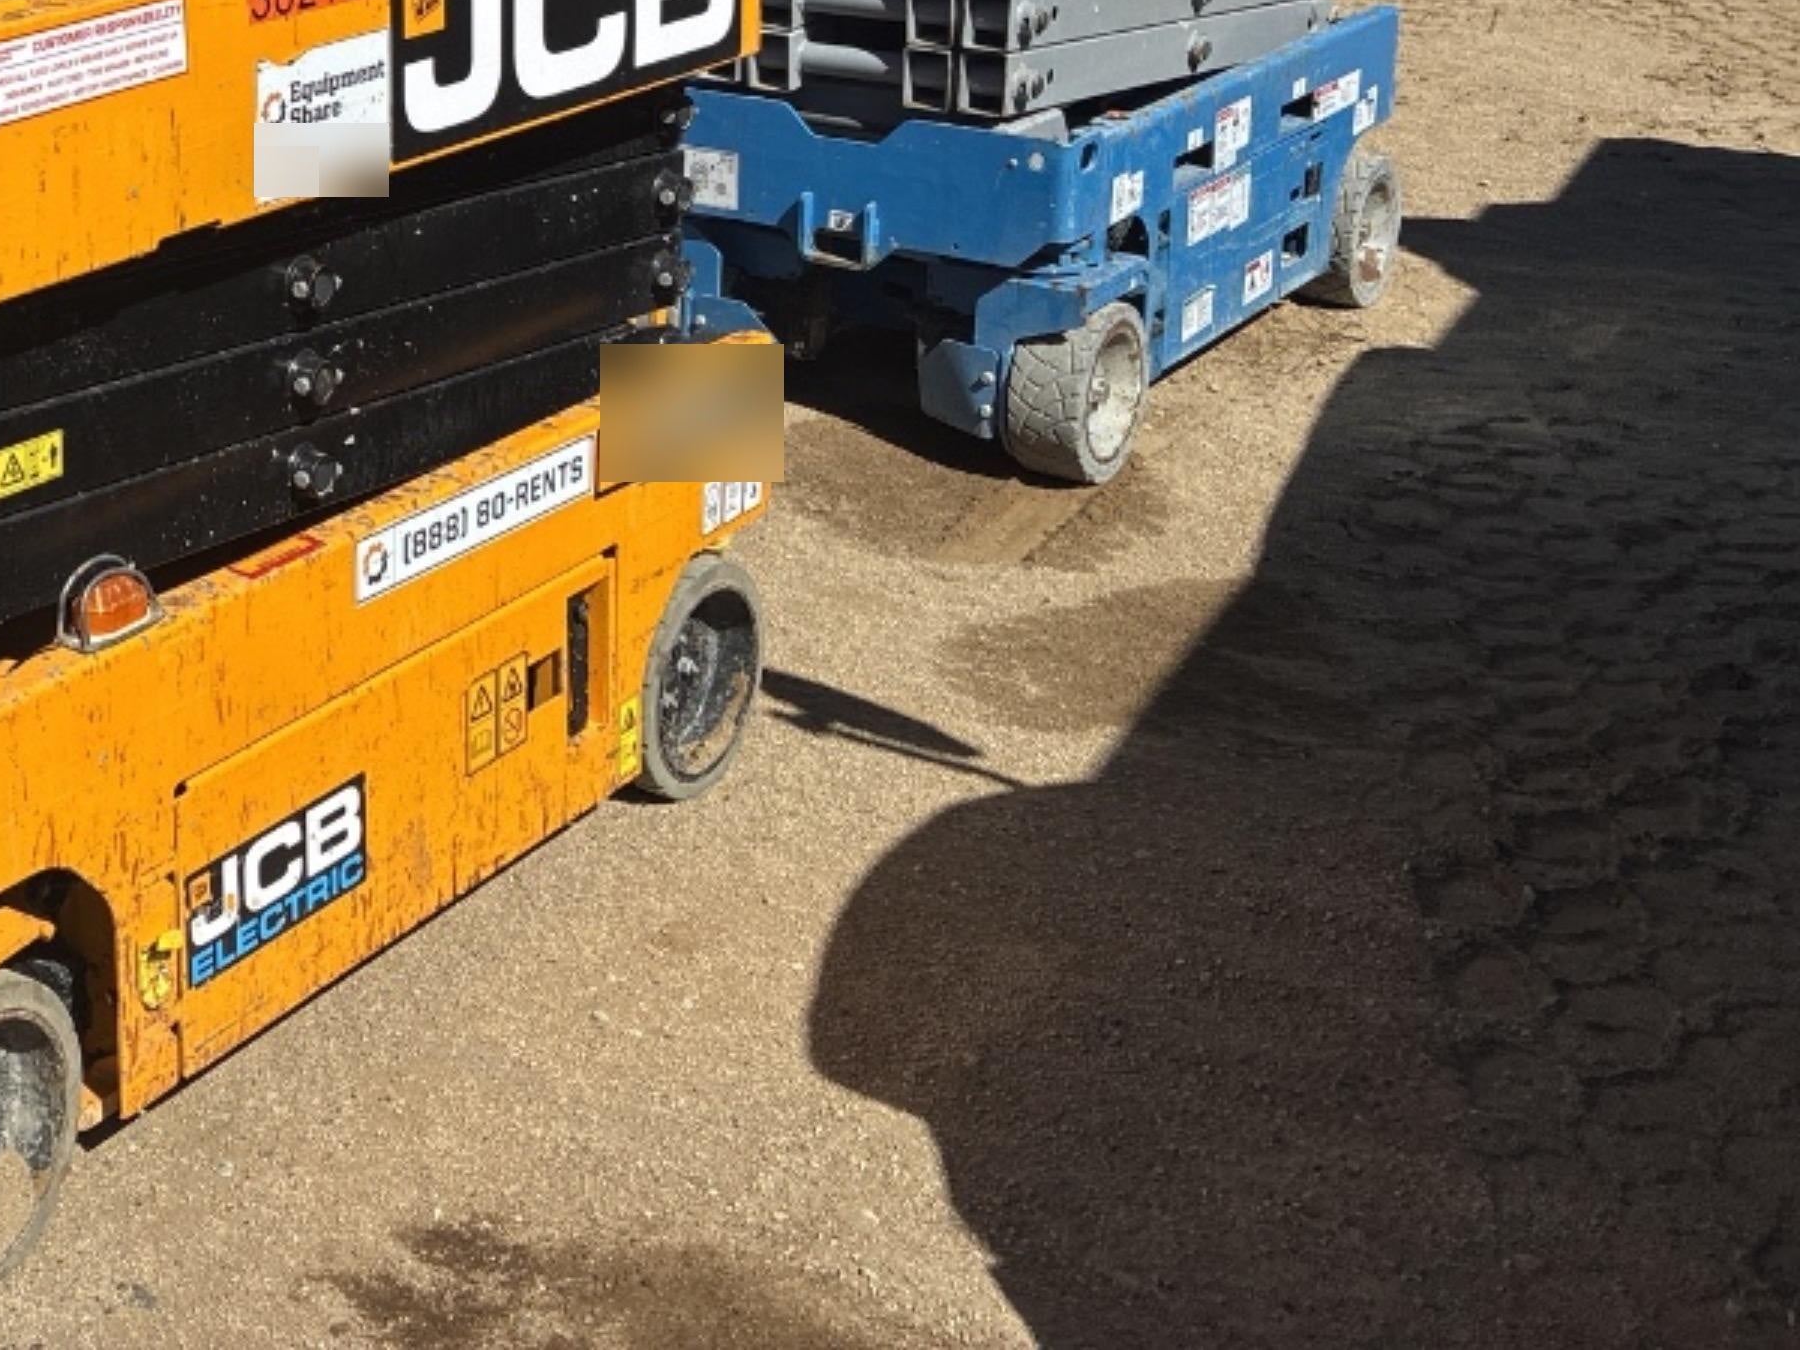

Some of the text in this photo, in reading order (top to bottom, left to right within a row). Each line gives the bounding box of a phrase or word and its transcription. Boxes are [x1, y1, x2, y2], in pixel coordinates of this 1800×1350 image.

[290, 59, 385, 103] Equipment
[290, 101, 343, 123] Share
[403, 507, 469, 565] (888)
[191, 785, 362, 946] JCB
[191, 853, 363, 986] ELECTRIC
